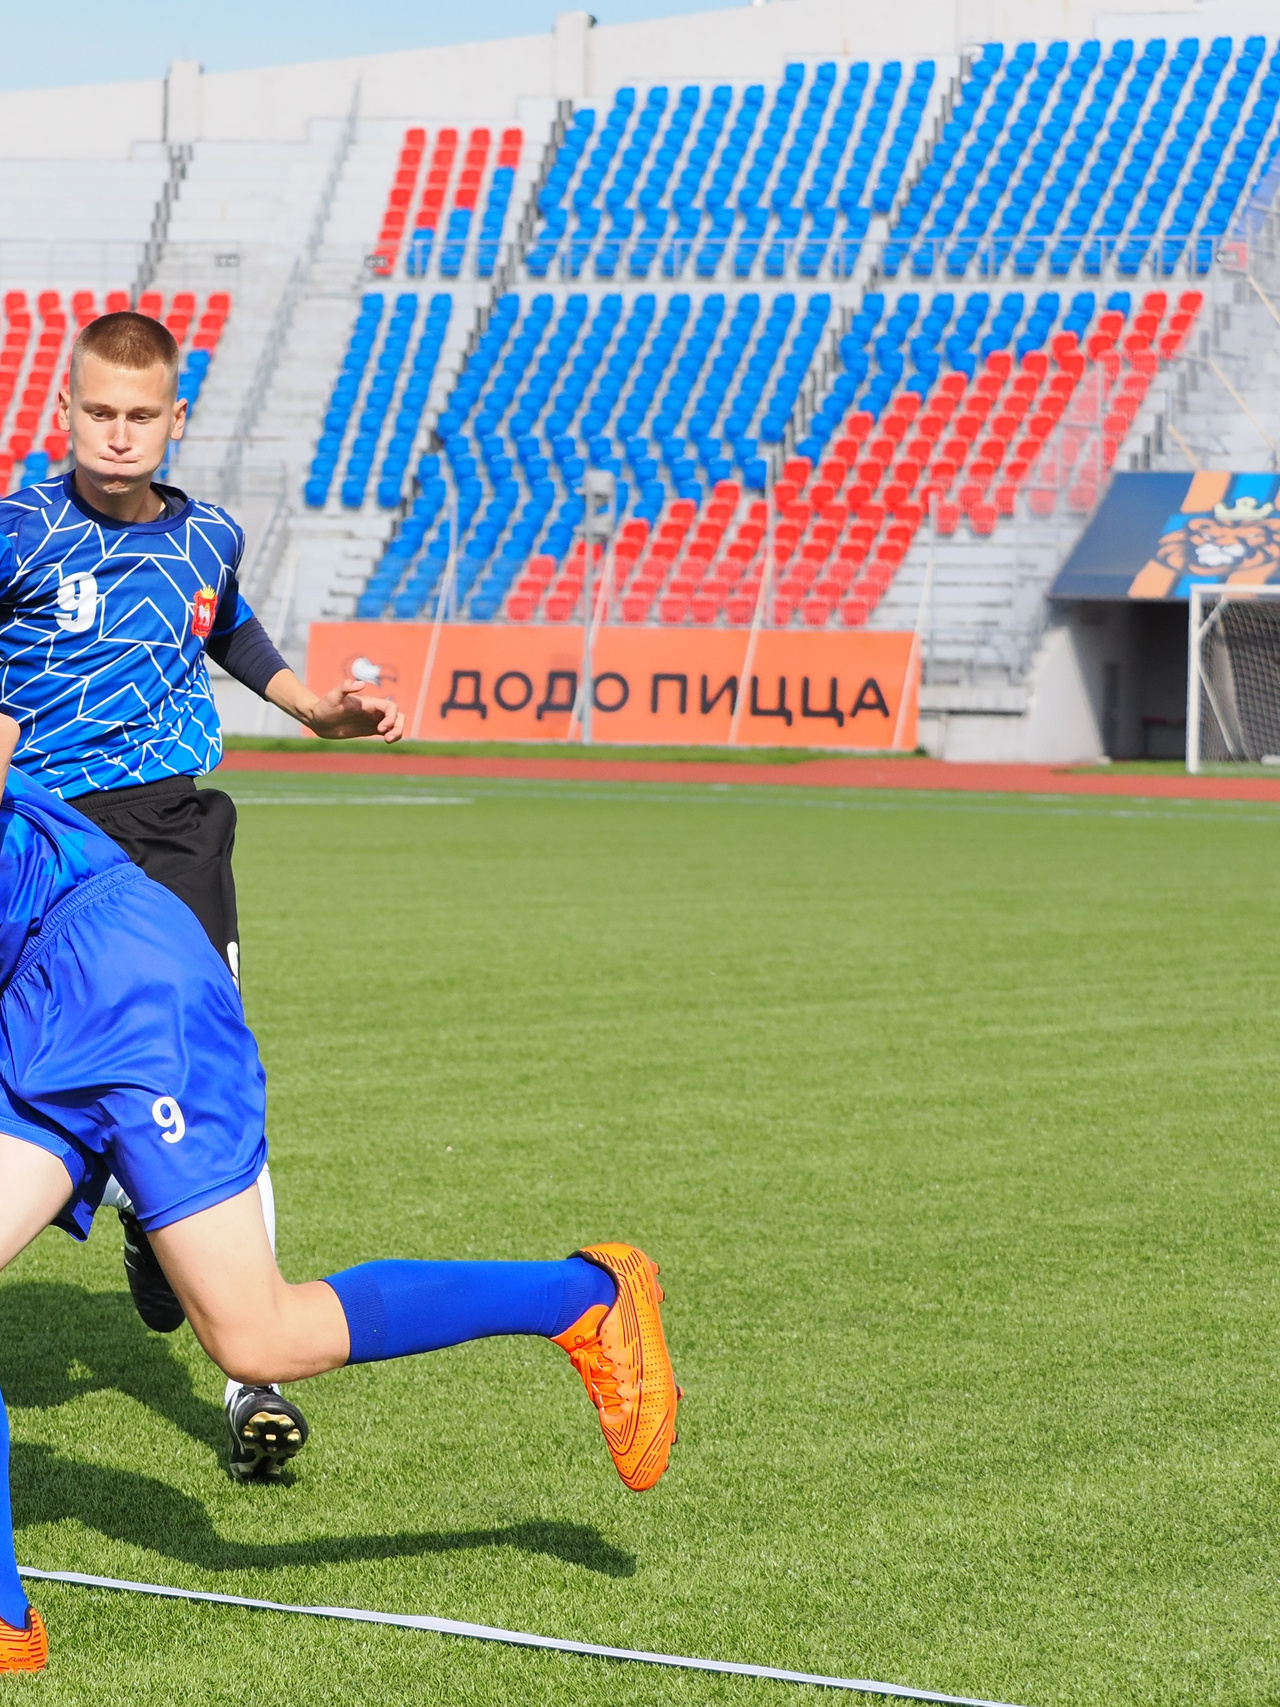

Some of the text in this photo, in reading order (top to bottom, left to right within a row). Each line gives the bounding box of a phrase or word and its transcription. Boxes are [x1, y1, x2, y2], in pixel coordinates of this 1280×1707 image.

[54, 571, 97, 633] 9
[440, 670, 890, 727] ДОДО ПИЦЦА
[151, 1096, 186, 1144] 9
